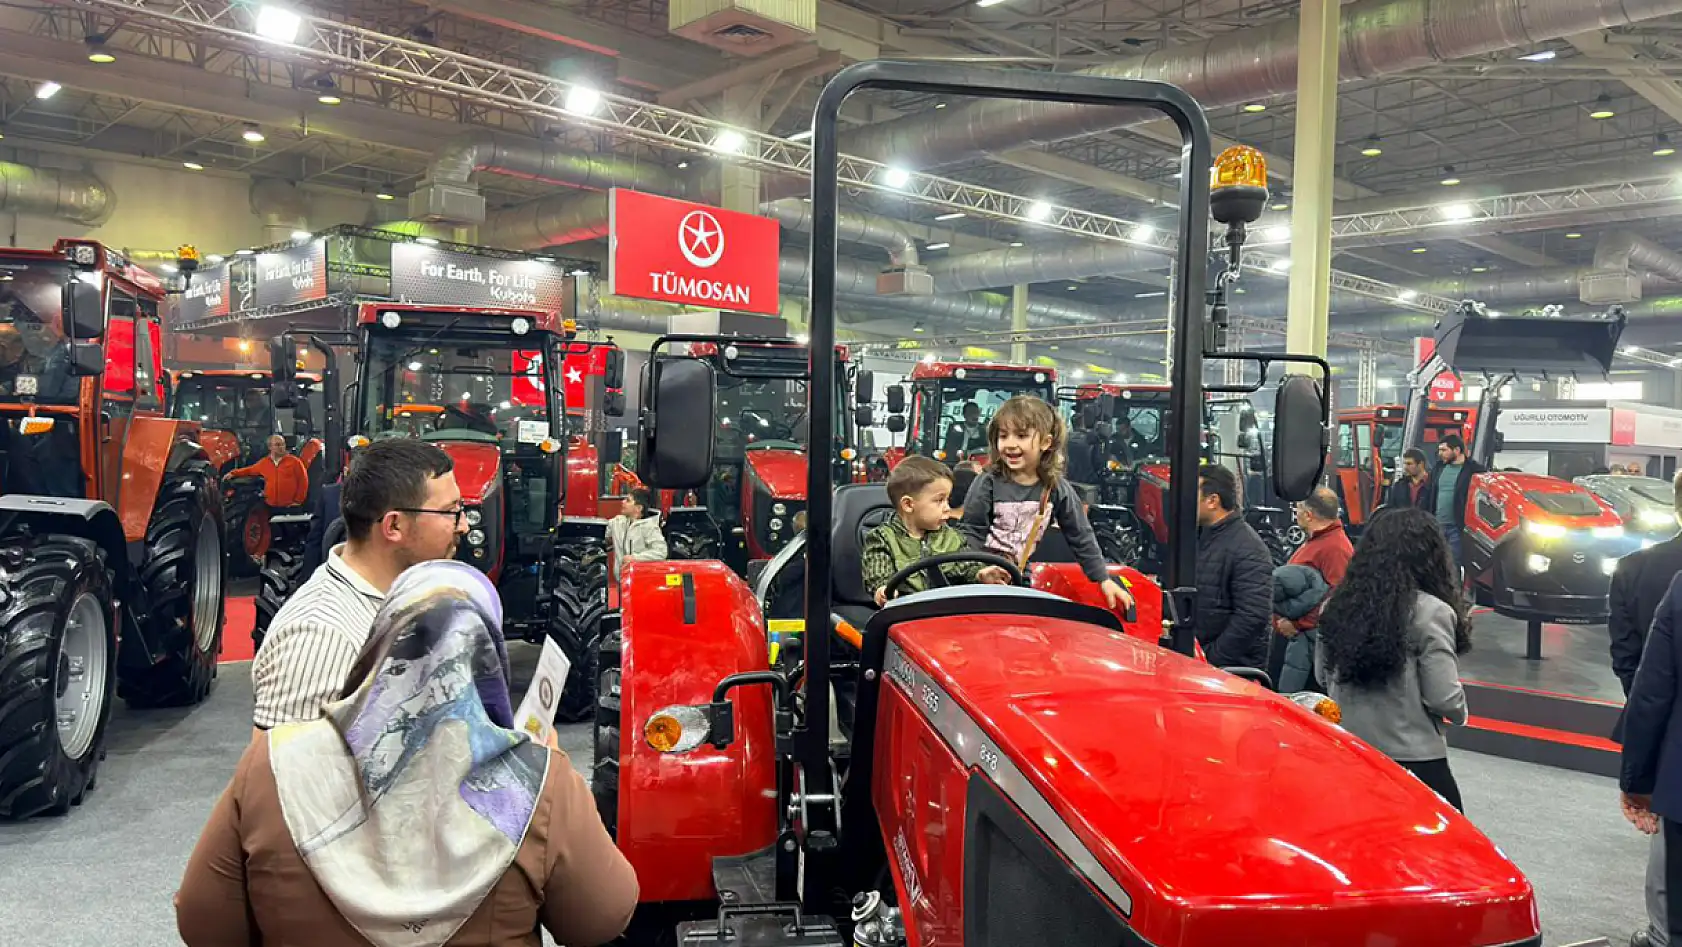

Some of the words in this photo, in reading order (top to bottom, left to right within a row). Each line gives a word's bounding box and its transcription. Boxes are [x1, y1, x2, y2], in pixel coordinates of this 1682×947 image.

[420, 260, 445, 277] For
[447, 264, 486, 285] Earth,
[488, 269, 510, 287] For
[649, 270, 751, 304] TÜMOSAN
[490, 286, 537, 304] Kubota
